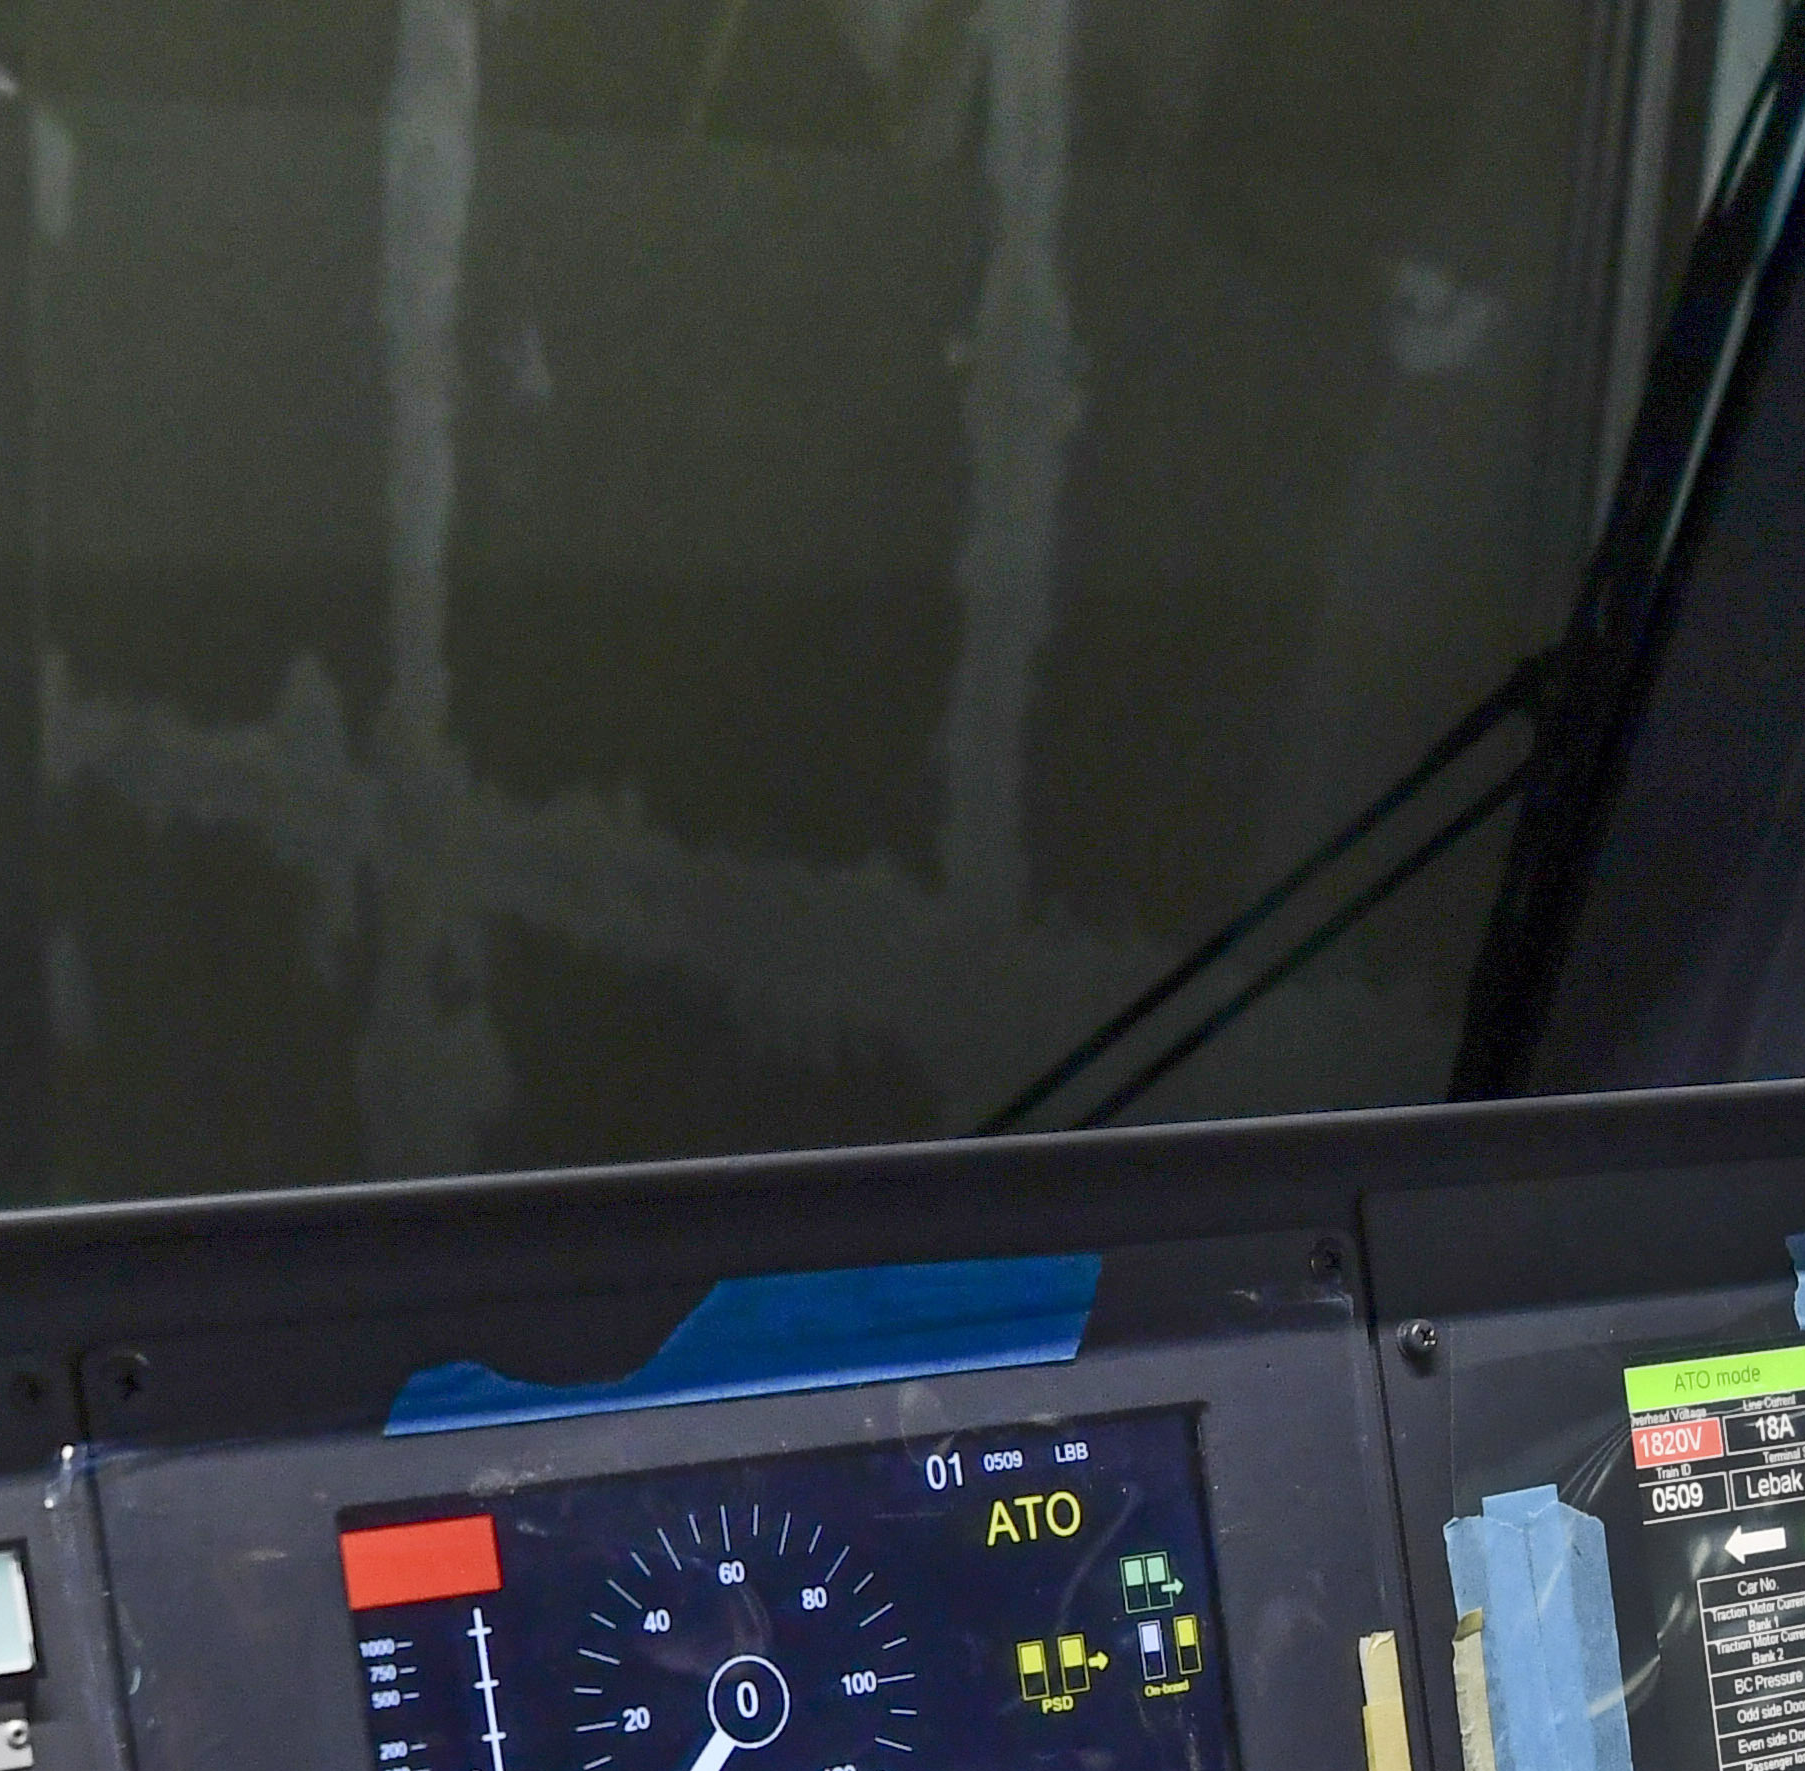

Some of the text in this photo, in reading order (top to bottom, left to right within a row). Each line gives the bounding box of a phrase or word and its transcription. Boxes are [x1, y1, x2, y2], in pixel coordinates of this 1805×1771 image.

[1672, 1363, 1761, 1392] ATO mode
[1753, 1412, 1795, 1442] 18A
[1638, 1426, 1704, 1459] 1820V
[926, 1442, 1089, 1491] 01 0509 LBB
[1651, 1481, 1704, 1513] 0509
[1745, 1467, 1803, 1499] Lebak
[982, 1489, 1083, 1547] ATO
[717, 1559, 746, 1585] 60
[1736, 1574, 1779, 1596] Car No.
[800, 1586, 828, 1611] 80
[641, 1607, 671, 1635] 40
[1747, 1615, 1779, 1632] Bank 1
[1751, 1647, 1784, 1665] Bank 2
[840, 1669, 878, 1697] 100
[1734, 1667, 1803, 1694] BC Pressure
[734, 1680, 760, 1719] 0
[1041, 1694, 1074, 1714] PSD
[1736, 1706, 1759, 1724] Odd
[1760, 1701, 1782, 1719] side
[621, 1705, 651, 1733] 20
[1737, 1734, 1764, 1754] Even
[1765, 1730, 1788, 1748] side
